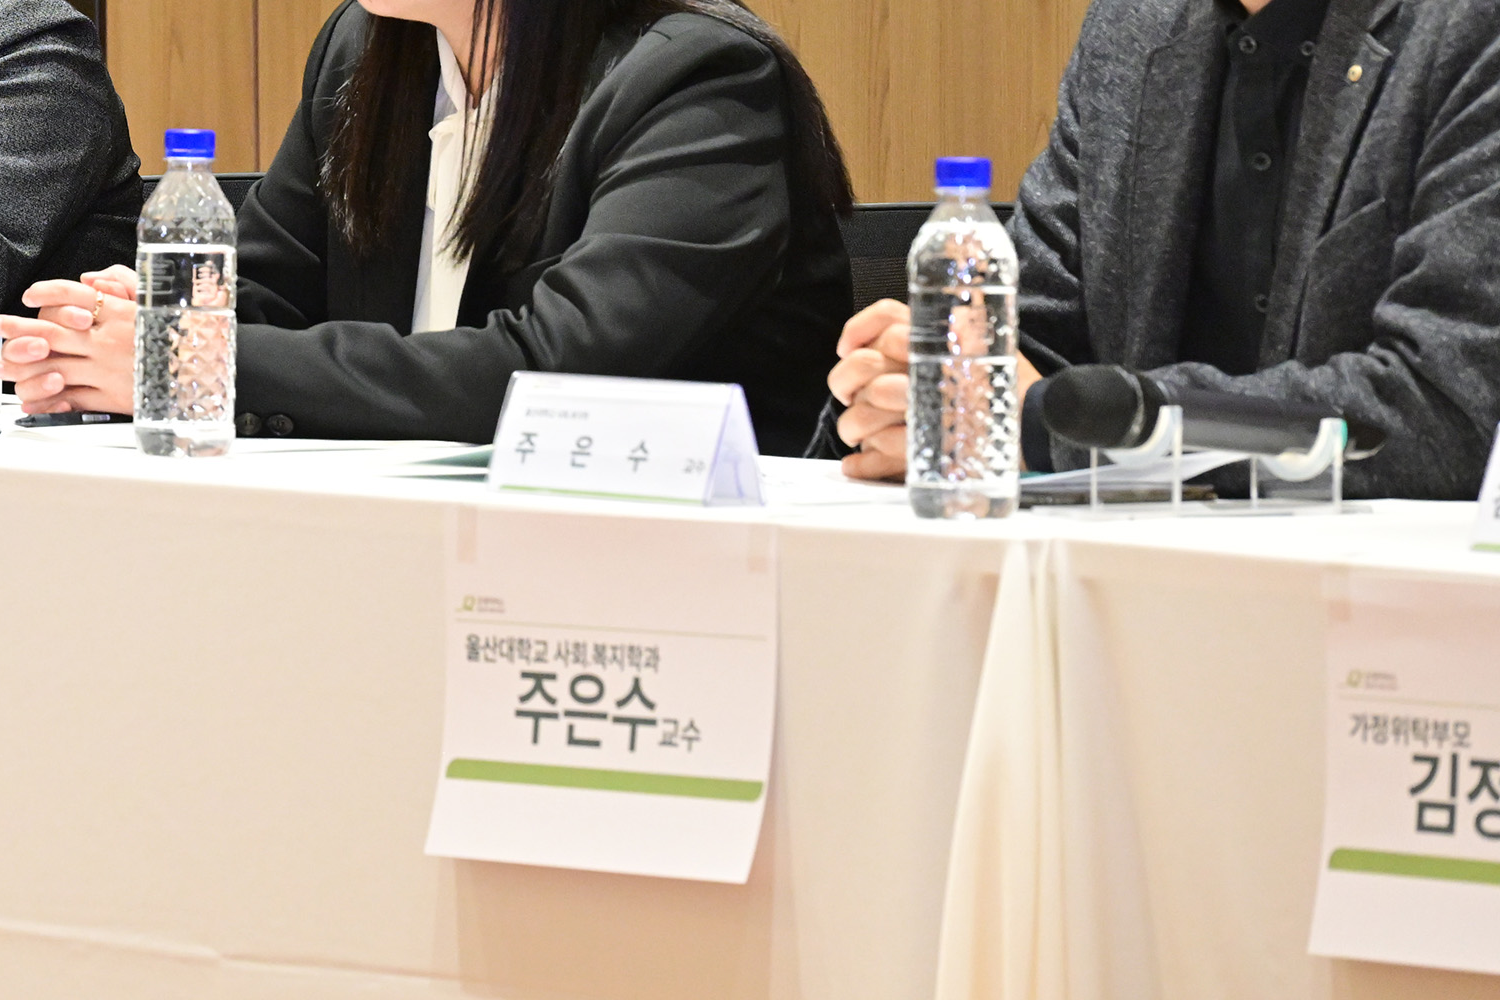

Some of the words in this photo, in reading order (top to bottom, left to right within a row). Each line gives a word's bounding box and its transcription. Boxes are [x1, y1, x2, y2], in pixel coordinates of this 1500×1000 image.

[466, 633, 550, 665] 울산대학교
[514, 670, 658, 753] 주은수
[658, 717, 702, 752] 교수
[1349, 711, 1472, 749] 가정위탁부모
